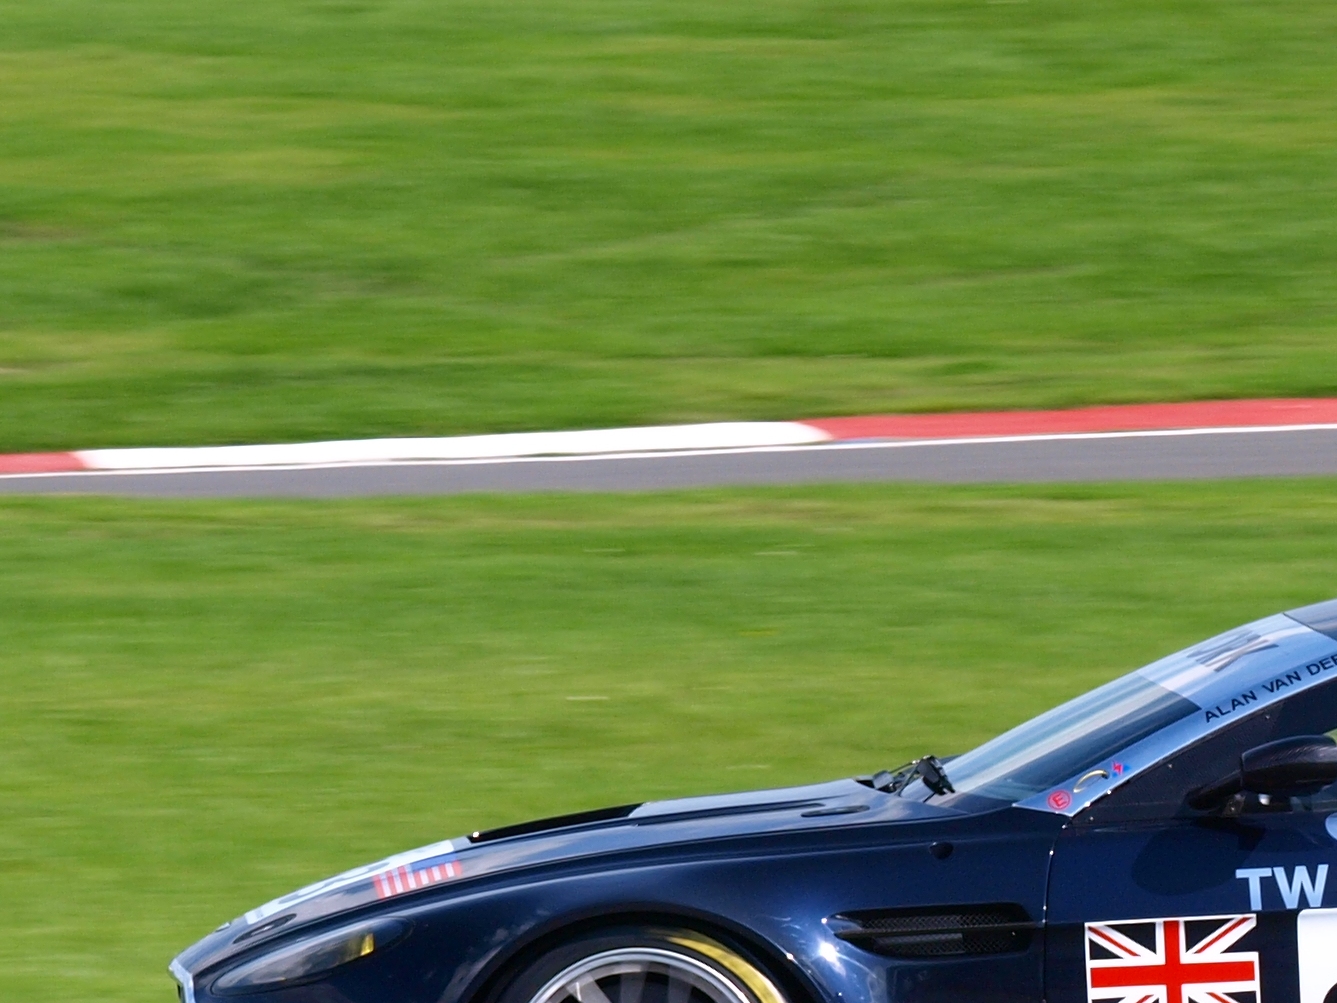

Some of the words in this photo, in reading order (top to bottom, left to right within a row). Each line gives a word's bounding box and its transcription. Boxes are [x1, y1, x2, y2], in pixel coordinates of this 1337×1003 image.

[1206, 690, 1258, 723] ALAN
[1263, 671, 1302, 693] VAN
[1235, 864, 1329, 911] TW
